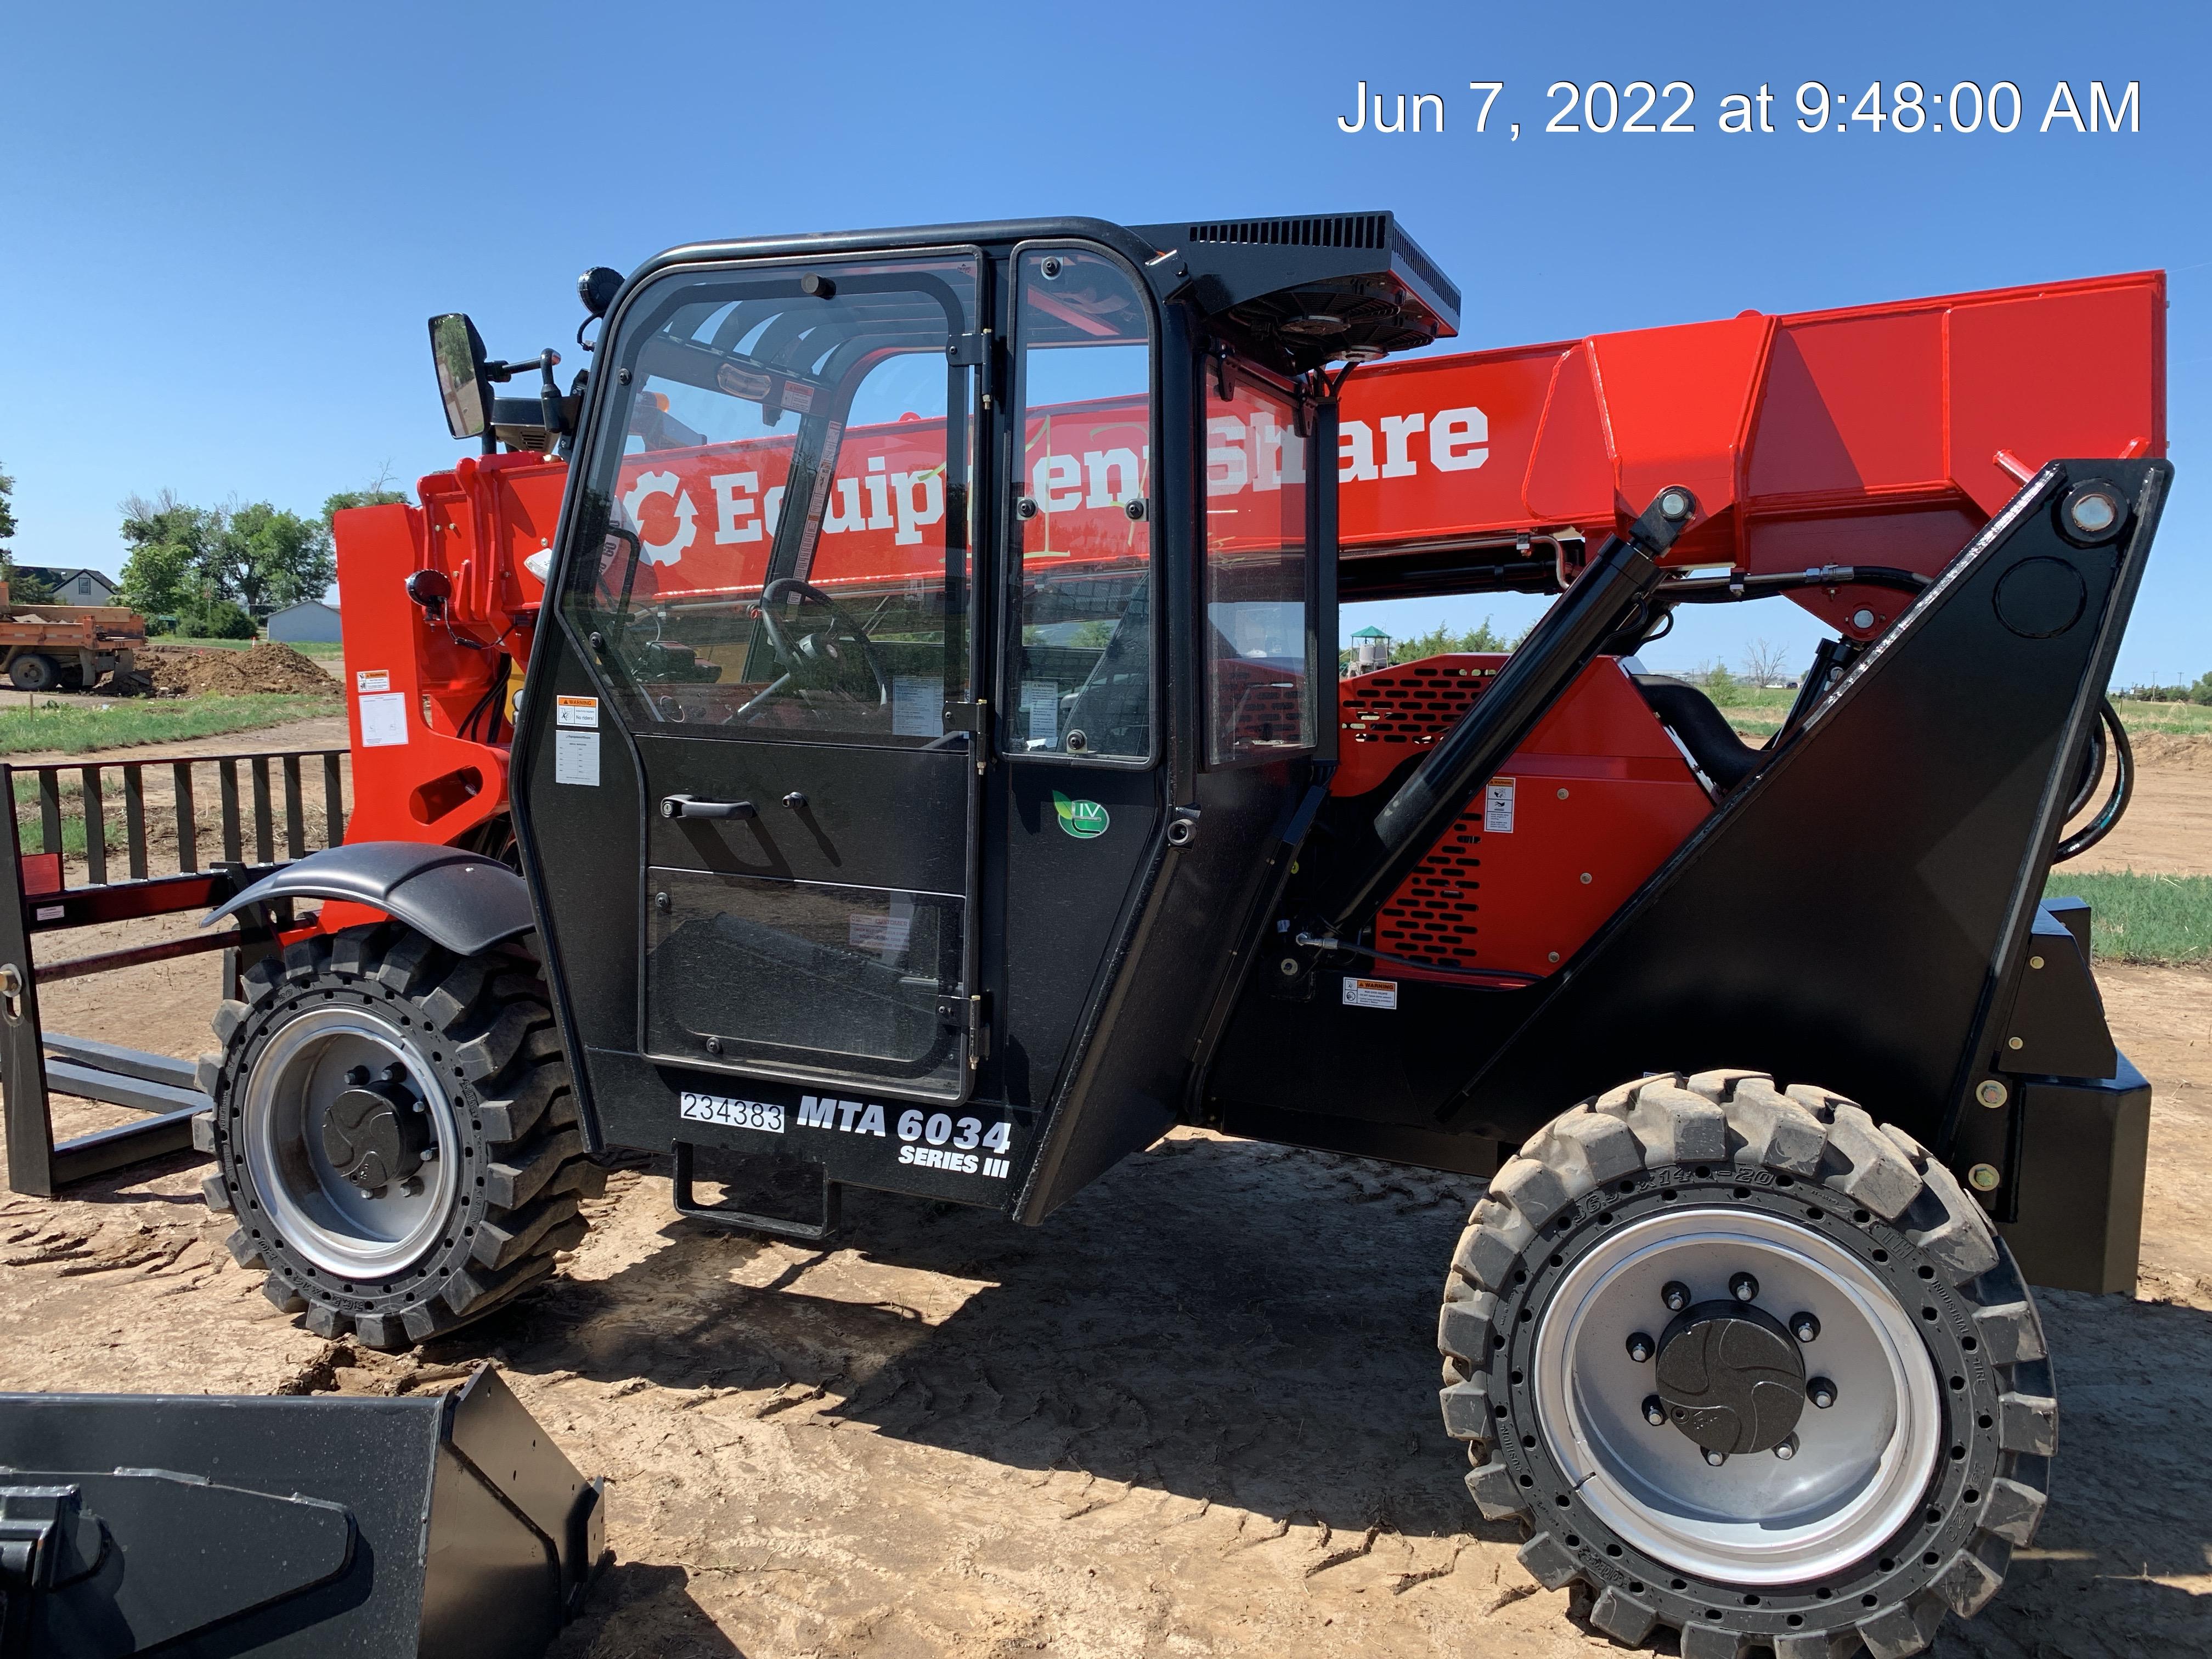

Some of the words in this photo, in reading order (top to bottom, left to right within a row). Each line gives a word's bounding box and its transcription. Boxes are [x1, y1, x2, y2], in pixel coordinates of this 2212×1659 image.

[683, 1093, 782, 1131] 234383
[797, 1095, 886, 1137] MTA
[897, 1109, 1011, 1154] 6034
[898, 1145, 978, 1173] SERIES
[982, 1158, 1010, 1178] III
[1931, 1279, 1970, 1334] INDUSTRIAL
[1972, 1359, 1986, 1385] TIRE
